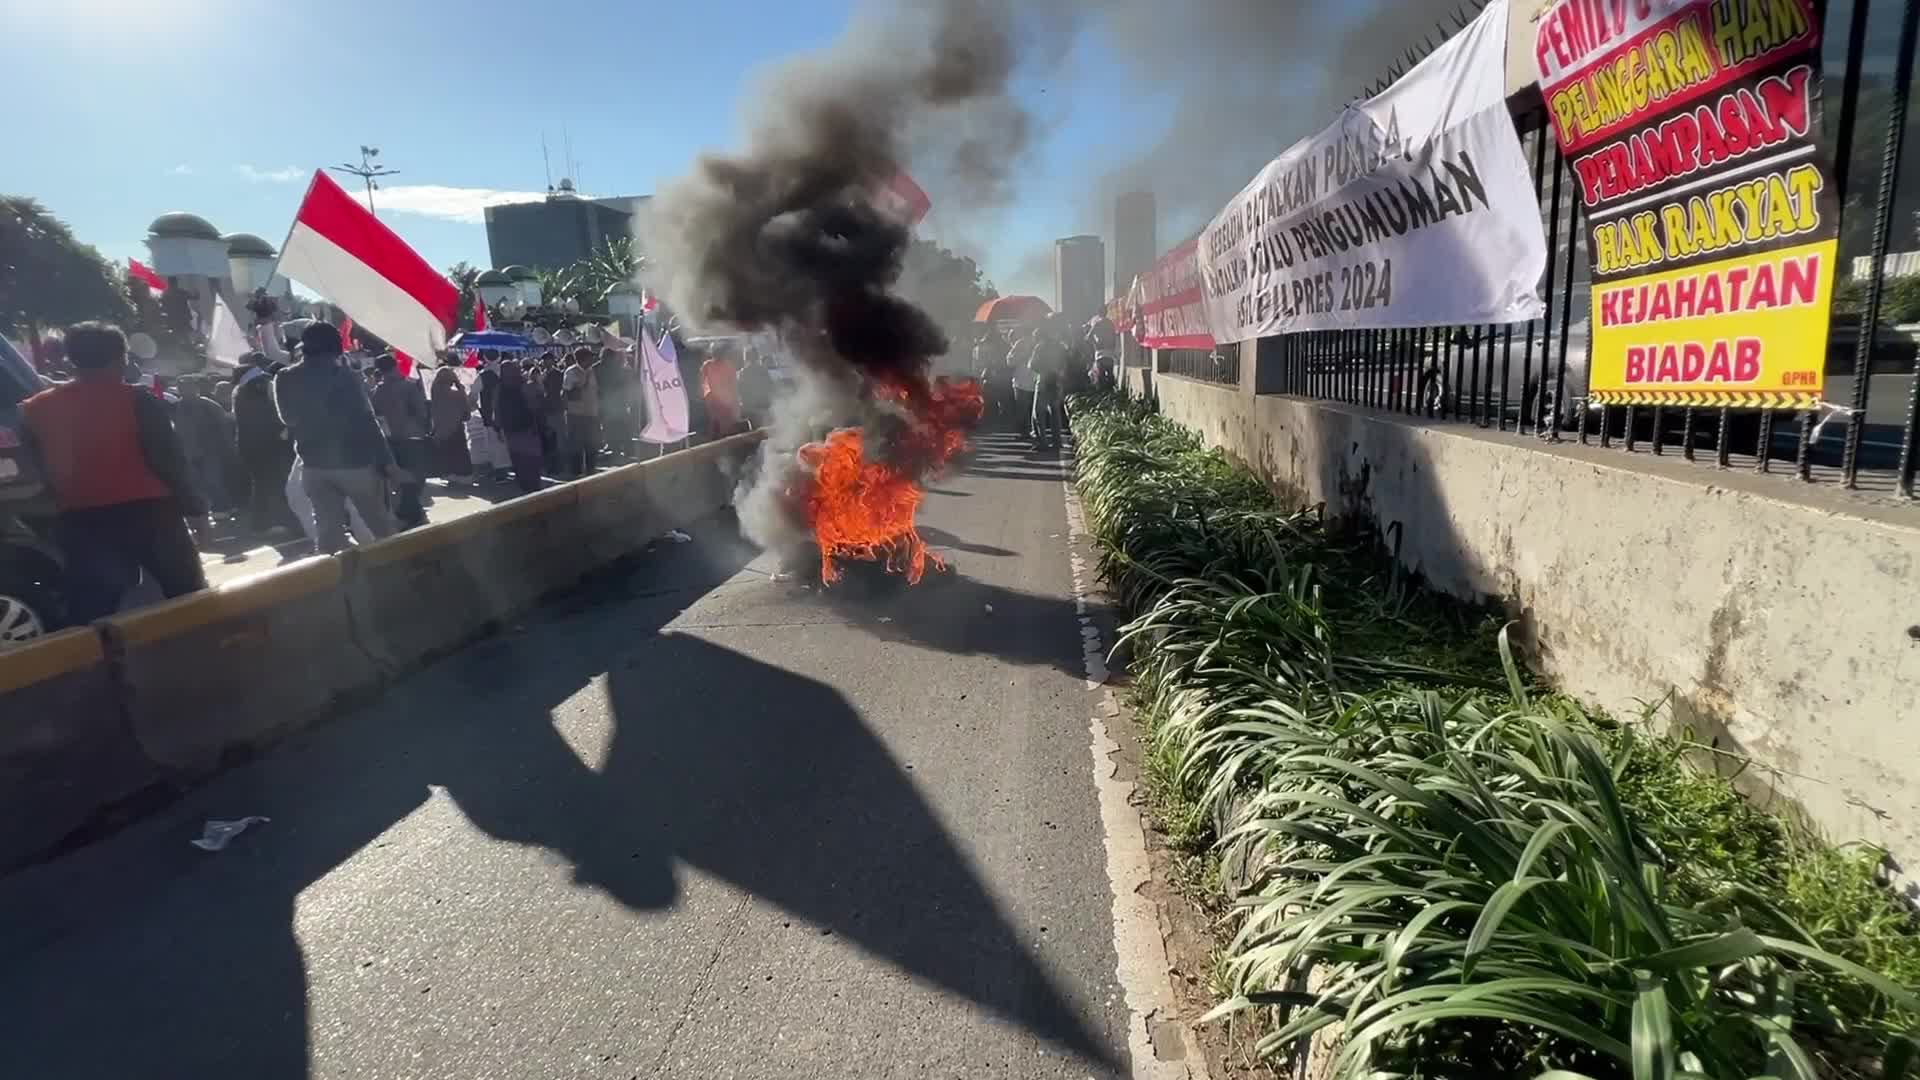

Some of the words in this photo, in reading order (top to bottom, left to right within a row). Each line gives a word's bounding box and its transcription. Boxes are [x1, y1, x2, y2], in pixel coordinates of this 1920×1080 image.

[1711, 0, 1808, 69] HAM
[1575, 67, 1808, 205] PERAMPASAN
[1289, 150, 1490, 261] PENGUMUMAN
[1595, 211, 1664, 274] HAK
[1663, 164, 1823, 260] RAKYAT
[1340, 258, 1391, 311] 2024
[1601, 256, 1819, 327] KEJAHATAN
[1625, 339, 1762, 384] BIADAB
